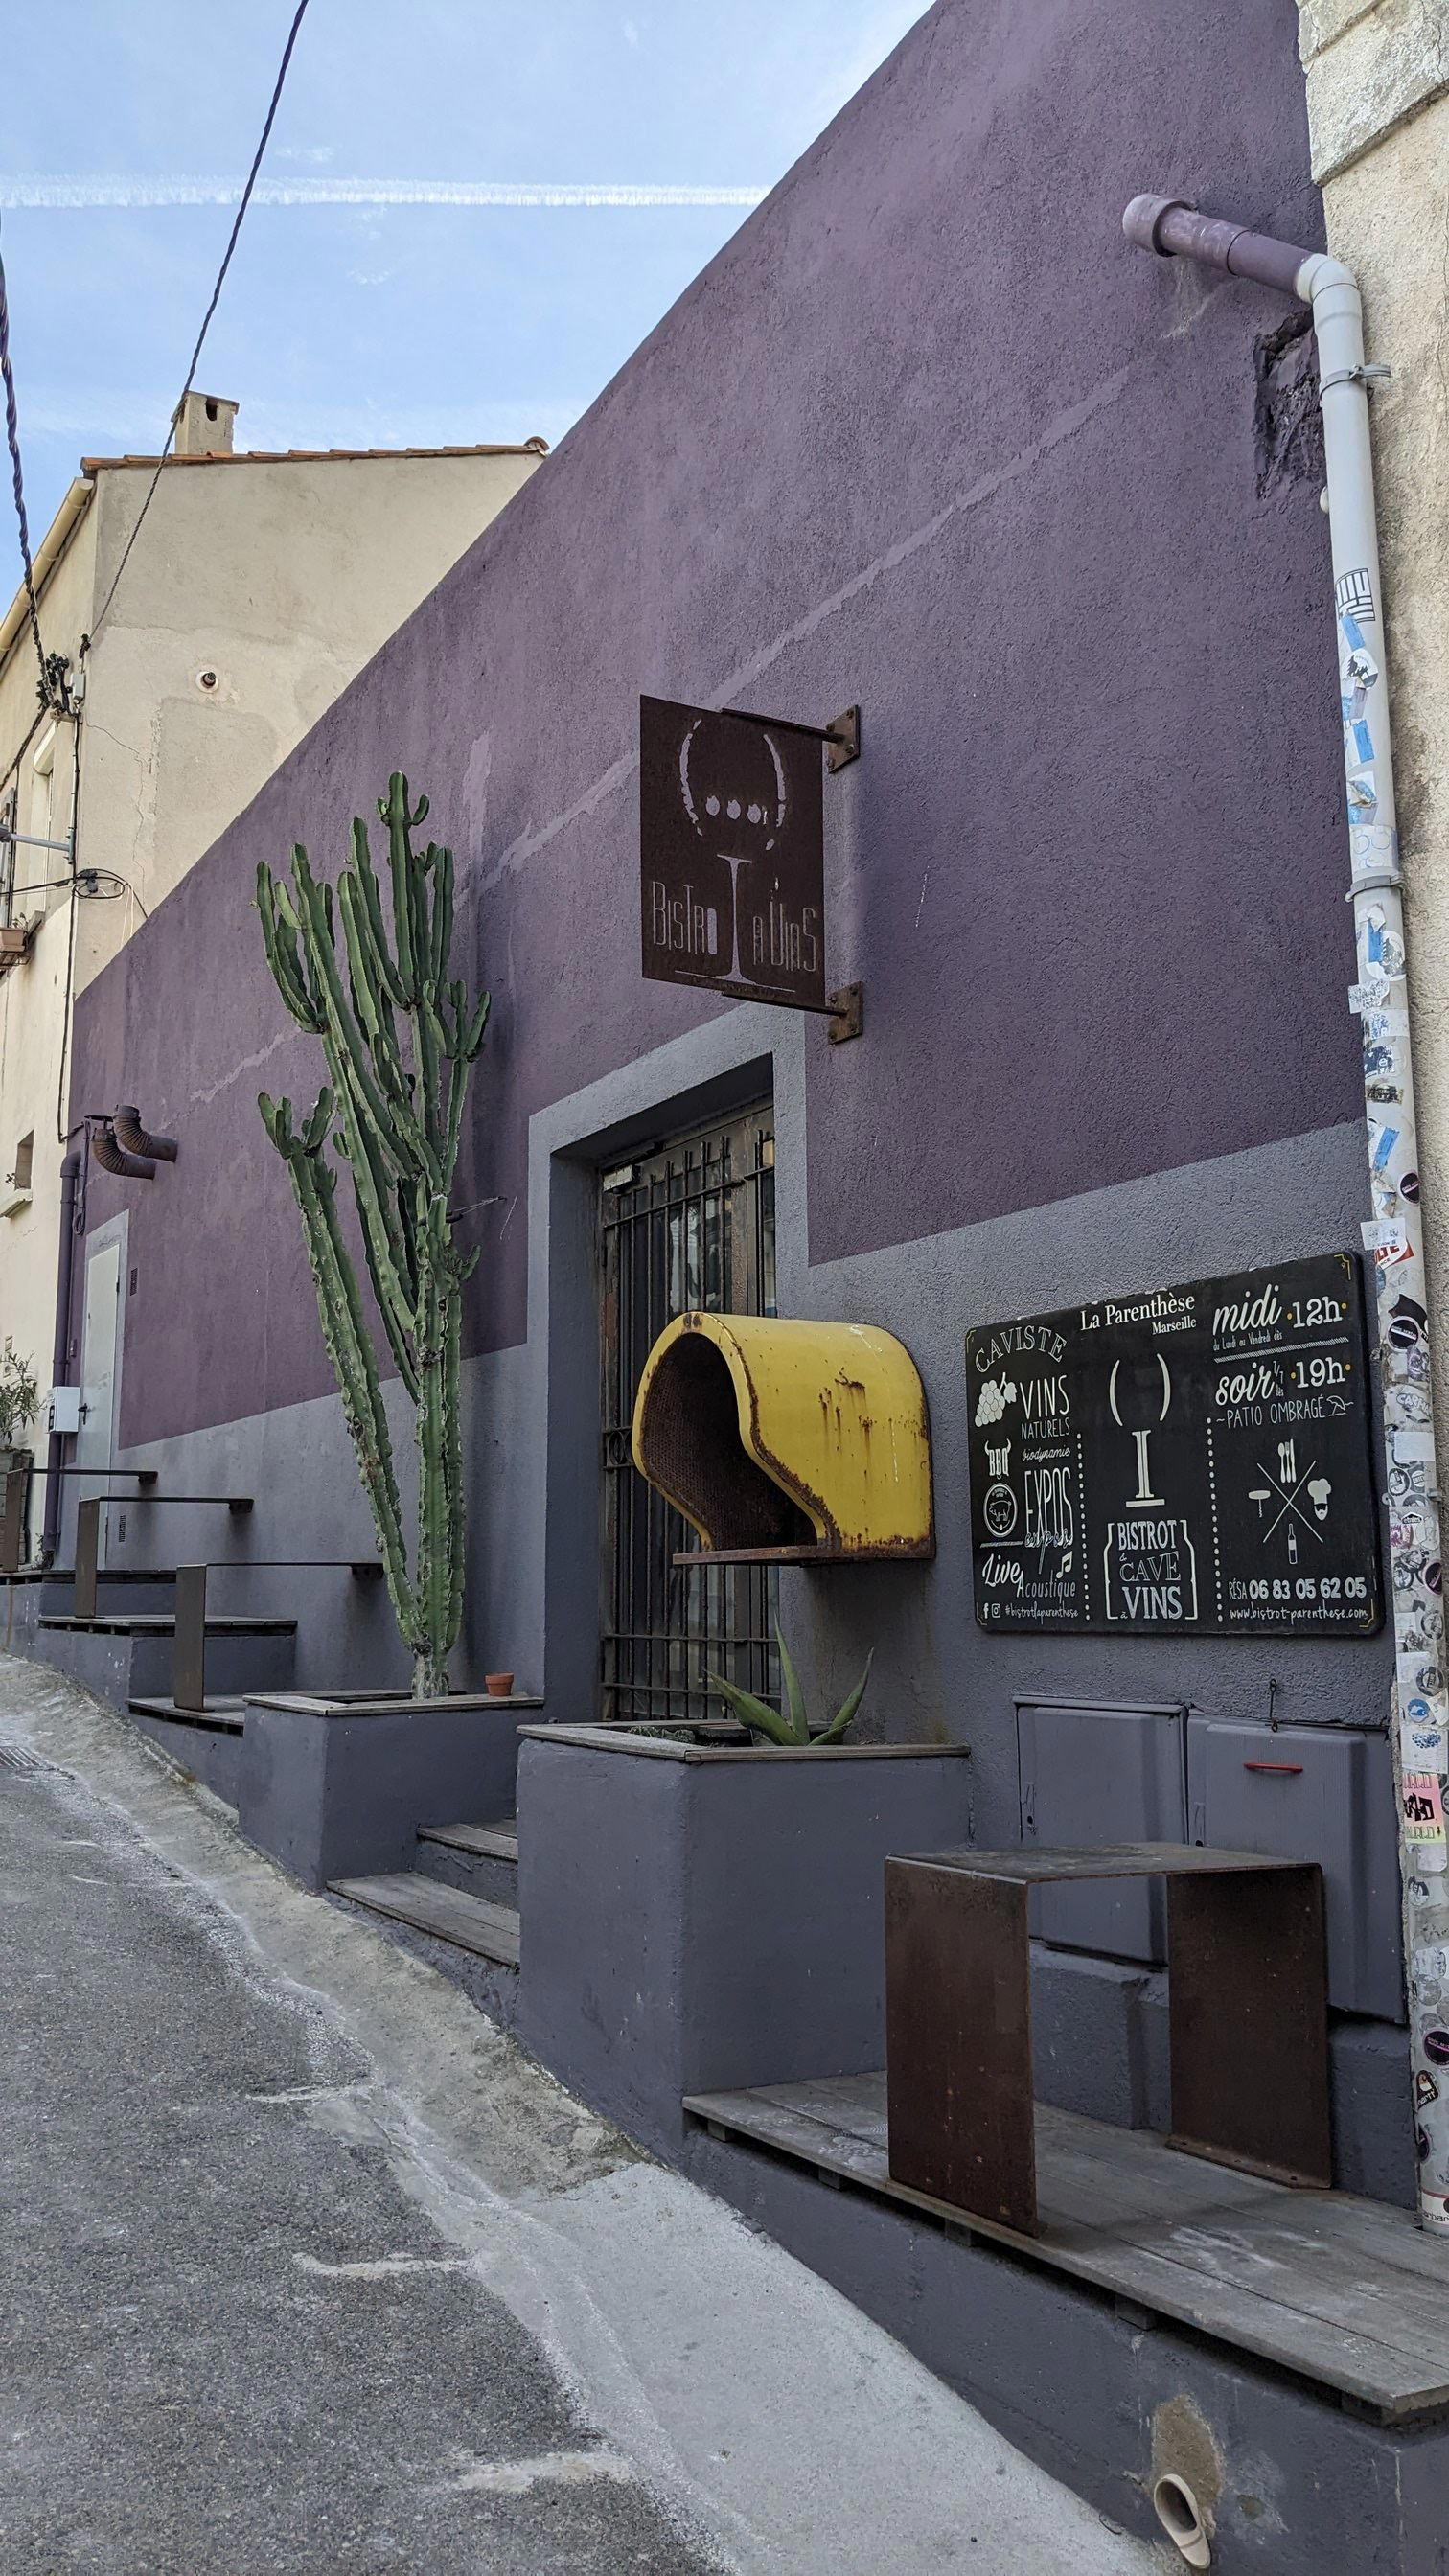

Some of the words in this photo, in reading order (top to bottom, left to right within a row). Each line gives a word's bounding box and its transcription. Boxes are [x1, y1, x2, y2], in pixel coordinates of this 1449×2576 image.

[1080, 1310, 1100, 1331] La
[1104, 1292, 1196, 1326] Parenthèse
[1151, 1315, 1197, 1335] Marseille
[1212, 1283, 1282, 1336] midi
[1292, 1296, 1344, 1328] 12h
[975, 1324, 1068, 1373] CAVISTE
[1020, 1374, 1070, 1420] VINS
[1215, 1362, 1276, 1406] soir
[1296, 1356, 1346, 1388] 19h
[1021, 1416, 1070, 1440] NATURELS
[1227, 1405, 1263, 1429] PATIO
[1270, 1393, 1326, 1424] OMBRAGÉ
[988, 1446, 1010, 1477] BBQ
[1022, 1444, 1071, 1463] biodynamie
[1024, 1466, 1074, 1548] EXPOS
[1117, 1519, 1177, 1551] BISTROT
[982, 1553, 1021, 1588] Live
[1119, 1550, 1182, 1582] CAVE
[1016, 1569, 1076, 1604] Acoustique
[1121, 1586, 1183, 1620] VINS
[1229, 1577, 1248, 1599] RÉSA
[1249, 1579, 1270, 1600] 06
[1272, 1579, 1291, 1600] 83
[1295, 1578, 1317, 1599] 05
[1320, 1577, 1342, 1598] 62
[1345, 1576, 1367, 1598] 05
[1005, 1600, 1079, 1625] #bistrotlaparenthese
[1230, 1599, 1368, 1625] www.bistrot-parenthese.com
